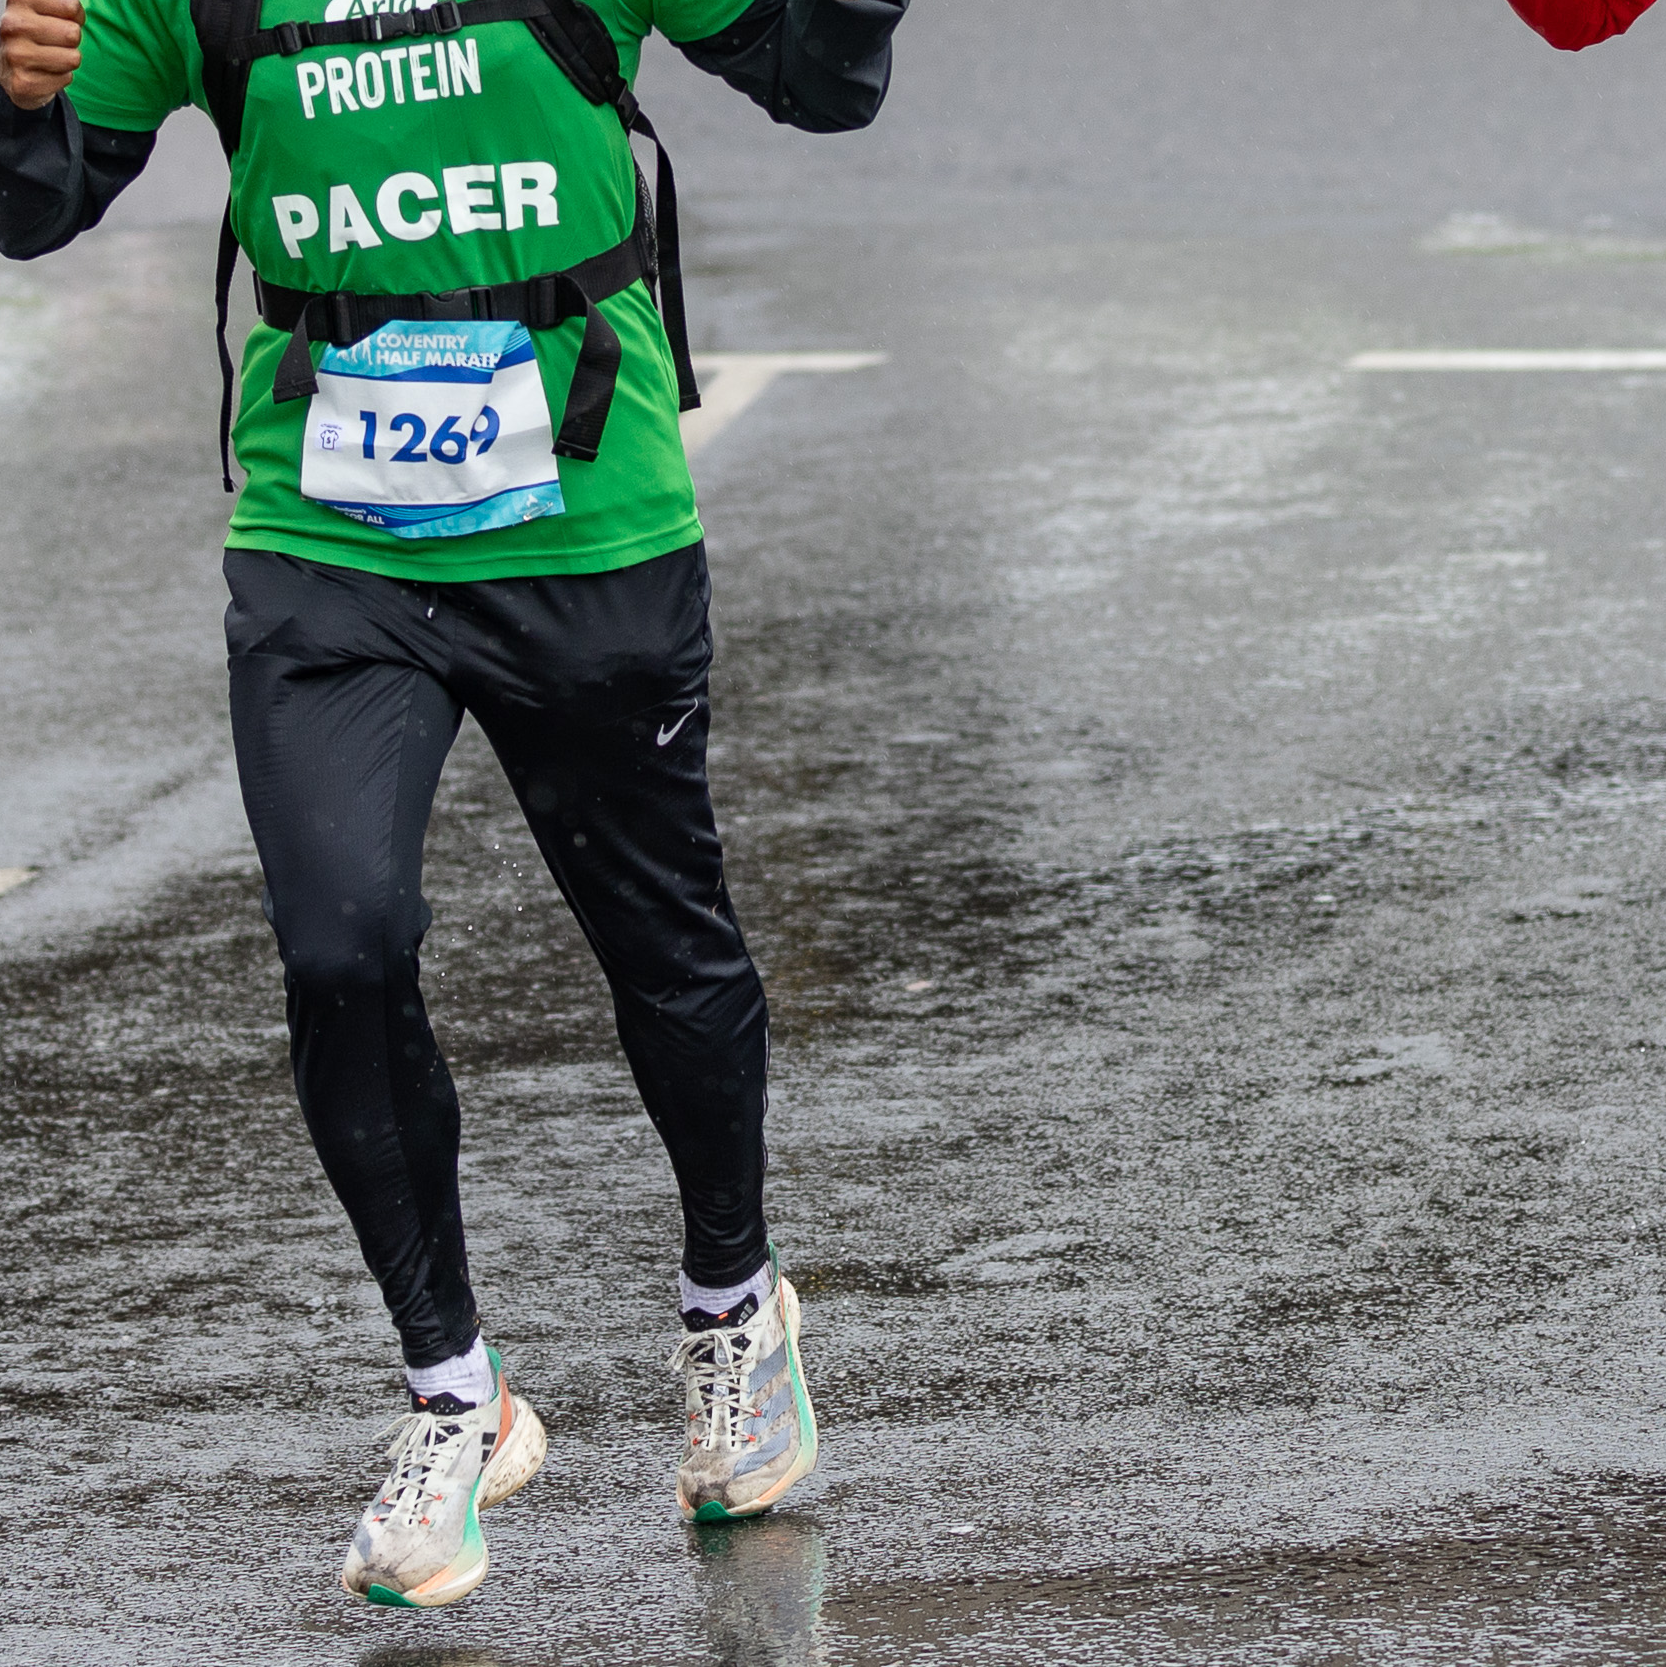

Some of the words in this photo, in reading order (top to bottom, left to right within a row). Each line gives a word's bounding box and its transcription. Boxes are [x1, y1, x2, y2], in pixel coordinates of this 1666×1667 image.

[296, 38, 482, 119] PROTEIN
[272, 161, 559, 259] PACER
[376, 333, 469, 350] COVENTRY
[376, 350, 421, 365] HALF
